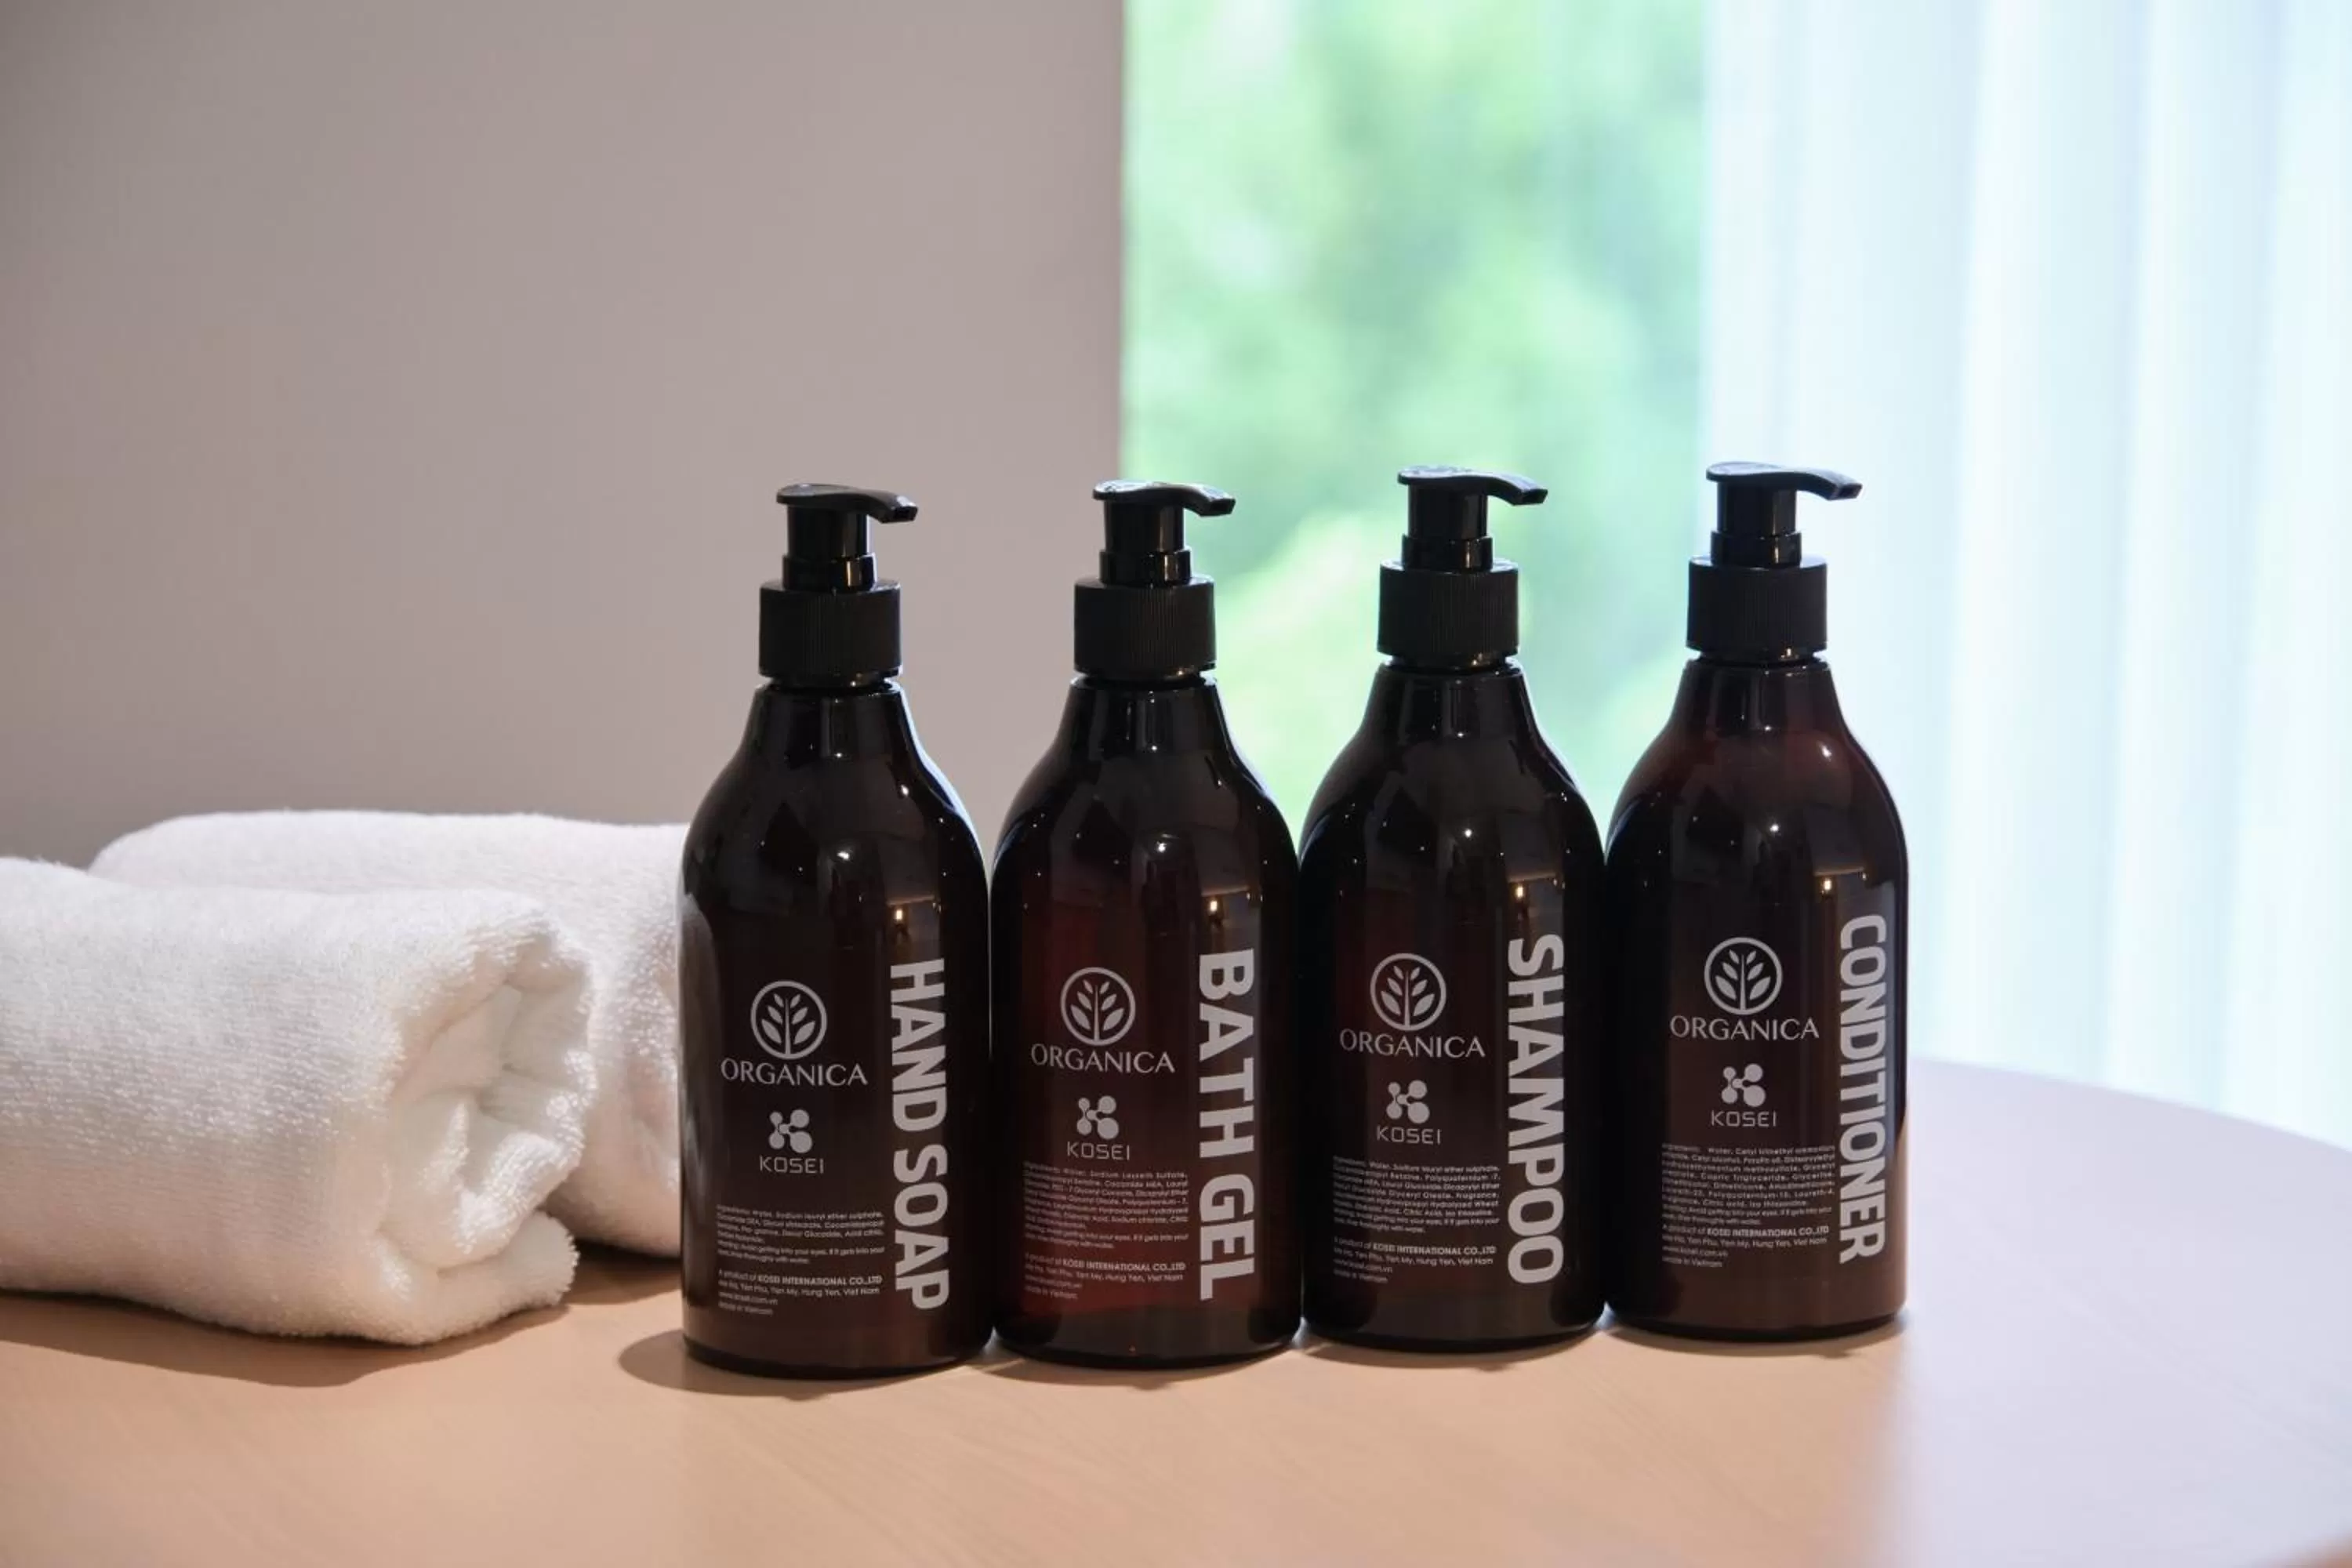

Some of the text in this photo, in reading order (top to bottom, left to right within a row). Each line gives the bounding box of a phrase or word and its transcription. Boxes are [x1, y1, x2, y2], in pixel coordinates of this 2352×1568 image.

[1670, 1015, 1819, 1040] ORGANICA
[1339, 1028, 1485, 1058] ORGANICA
[1031, 1044, 1175, 1073] ORGANICA
[720, 1058, 868, 1087] ORGANICA
[1839, 915, 1886, 1264] CONDITIONER
[1507, 934, 1564, 1284] SHAMPOO
[1710, 1109, 1777, 1127] KOSEI
[891, 957, 949, 1309] HAND SOAP
[1199, 948, 1254, 1301] BATH GEL
[1376, 1125, 1441, 1145] KOSEI
[1067, 1141, 1130, 1161] KOSEI
[760, 1155, 823, 1174] KOSEI
[1733, 1228, 1796, 1237] INTERNATIONAL
[1396, 1245, 1461, 1255] INTERNATIONAL
[1063, 1258, 1084, 1268] KOSEI
[1087, 1261, 1151, 1271] INTERNATIONAL
[782, 1276, 846, 1286] INTERNATIONAL
